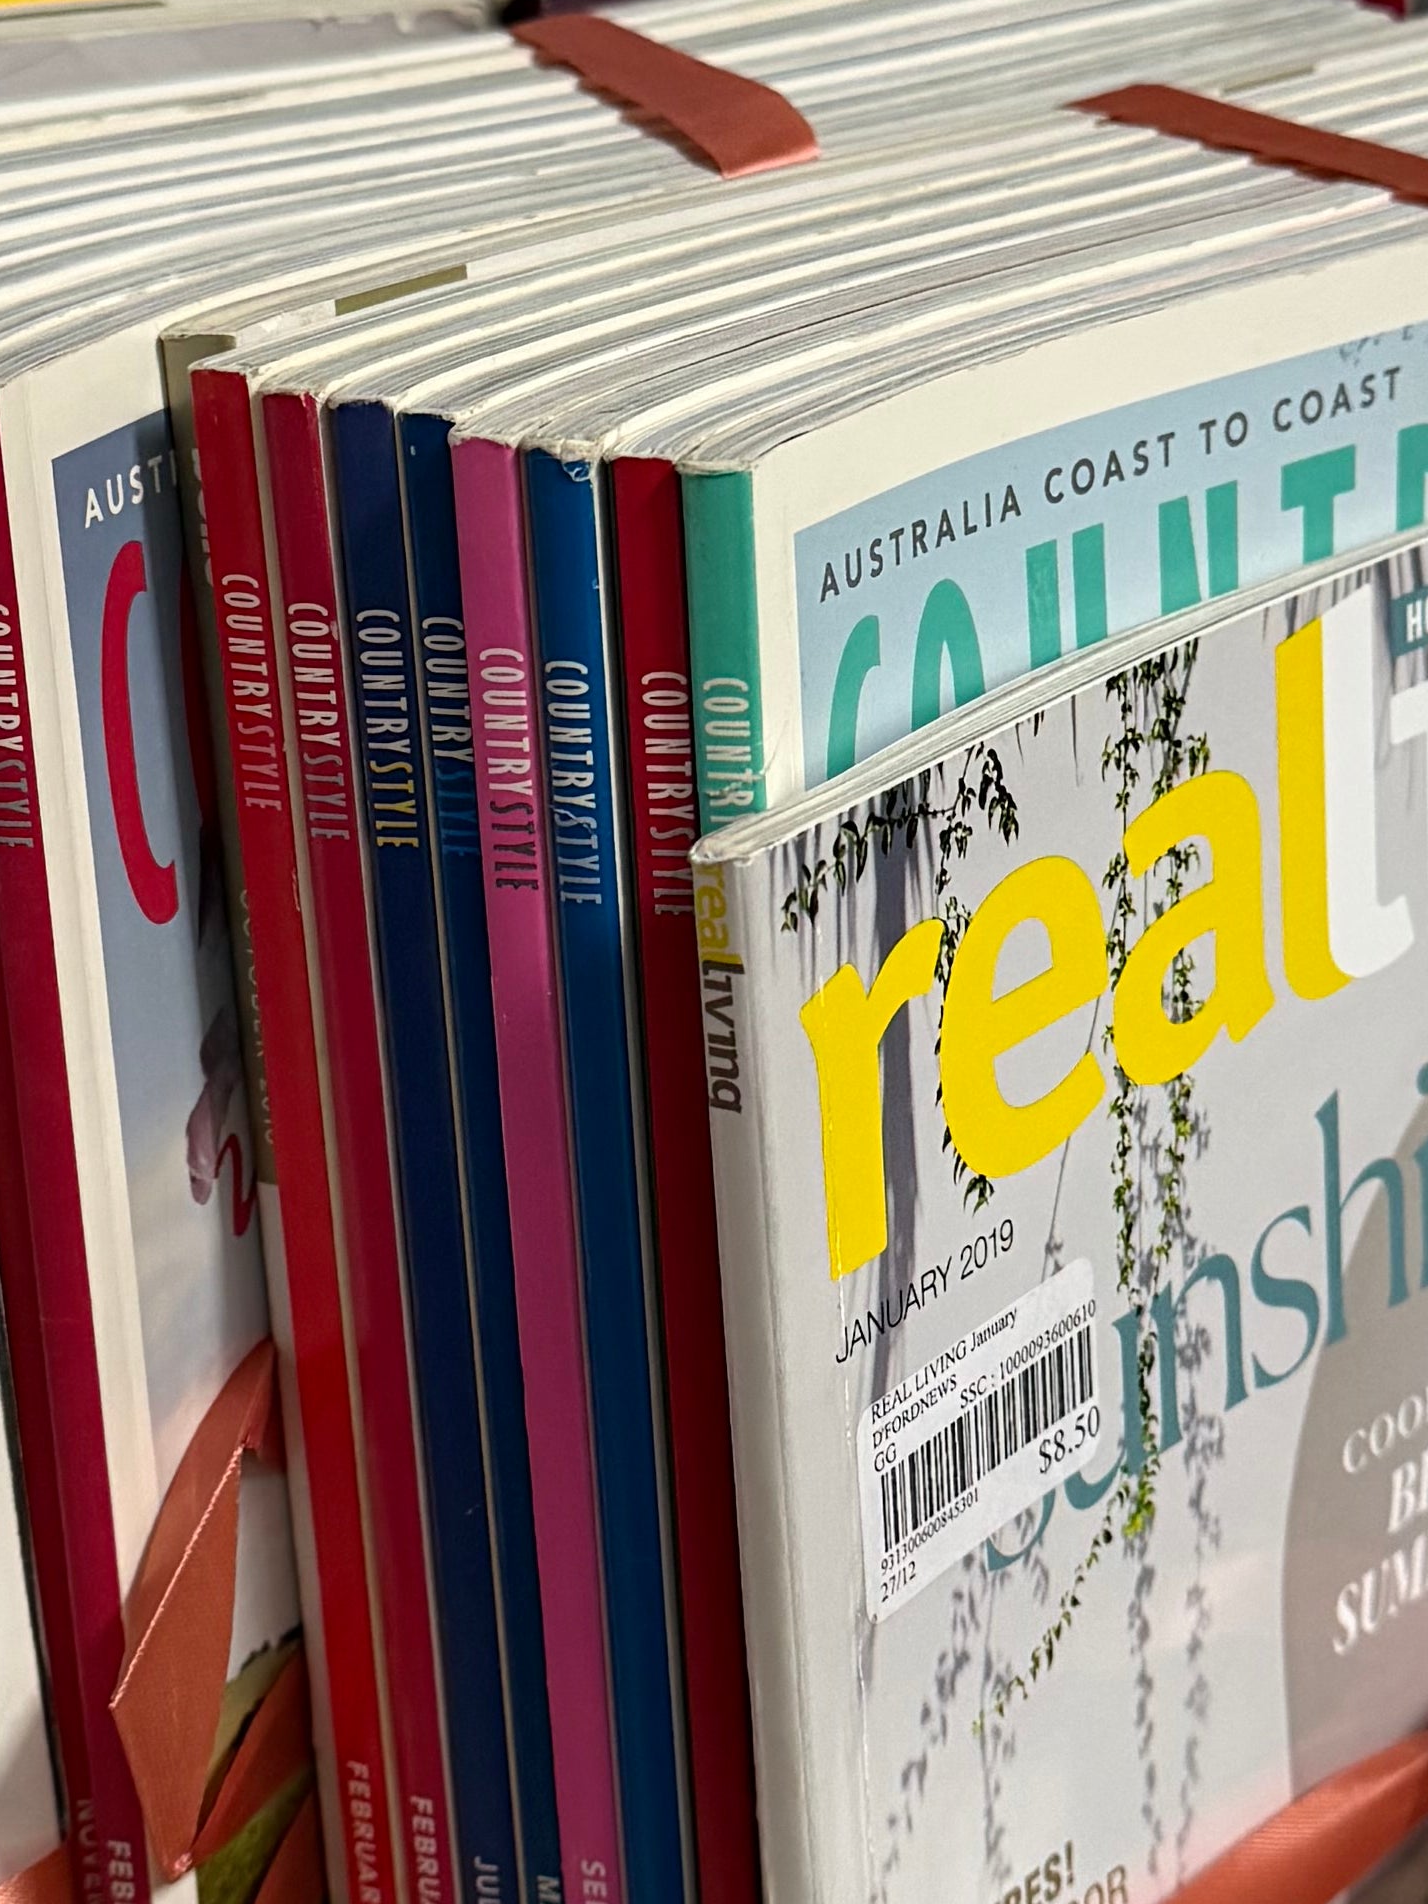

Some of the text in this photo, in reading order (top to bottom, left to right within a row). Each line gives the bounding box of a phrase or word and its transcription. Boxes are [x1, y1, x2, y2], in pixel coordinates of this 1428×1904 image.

[820, 365, 1404, 604] AUSTRALIA COAST TO COAST
[221, 573, 283, 814] COUNTRYSTYLE
[288, 602, 351, 843] COUNTRYSTYLE
[357, 609, 420, 850] COUNTRYSTYLE
[836, 1218, 1015, 1364] JANUARY 2019
[871, 1307, 1018, 1425] REAL LIVING January
[872, 1373, 958, 1449] D'FORDNEWS
[959, 1374, 988, 1410] SSC
[873, 1443, 898, 1473] GG
[1038, 1405, 1101, 1475] $8.50
[880, 1561, 917, 1604] 27/12
